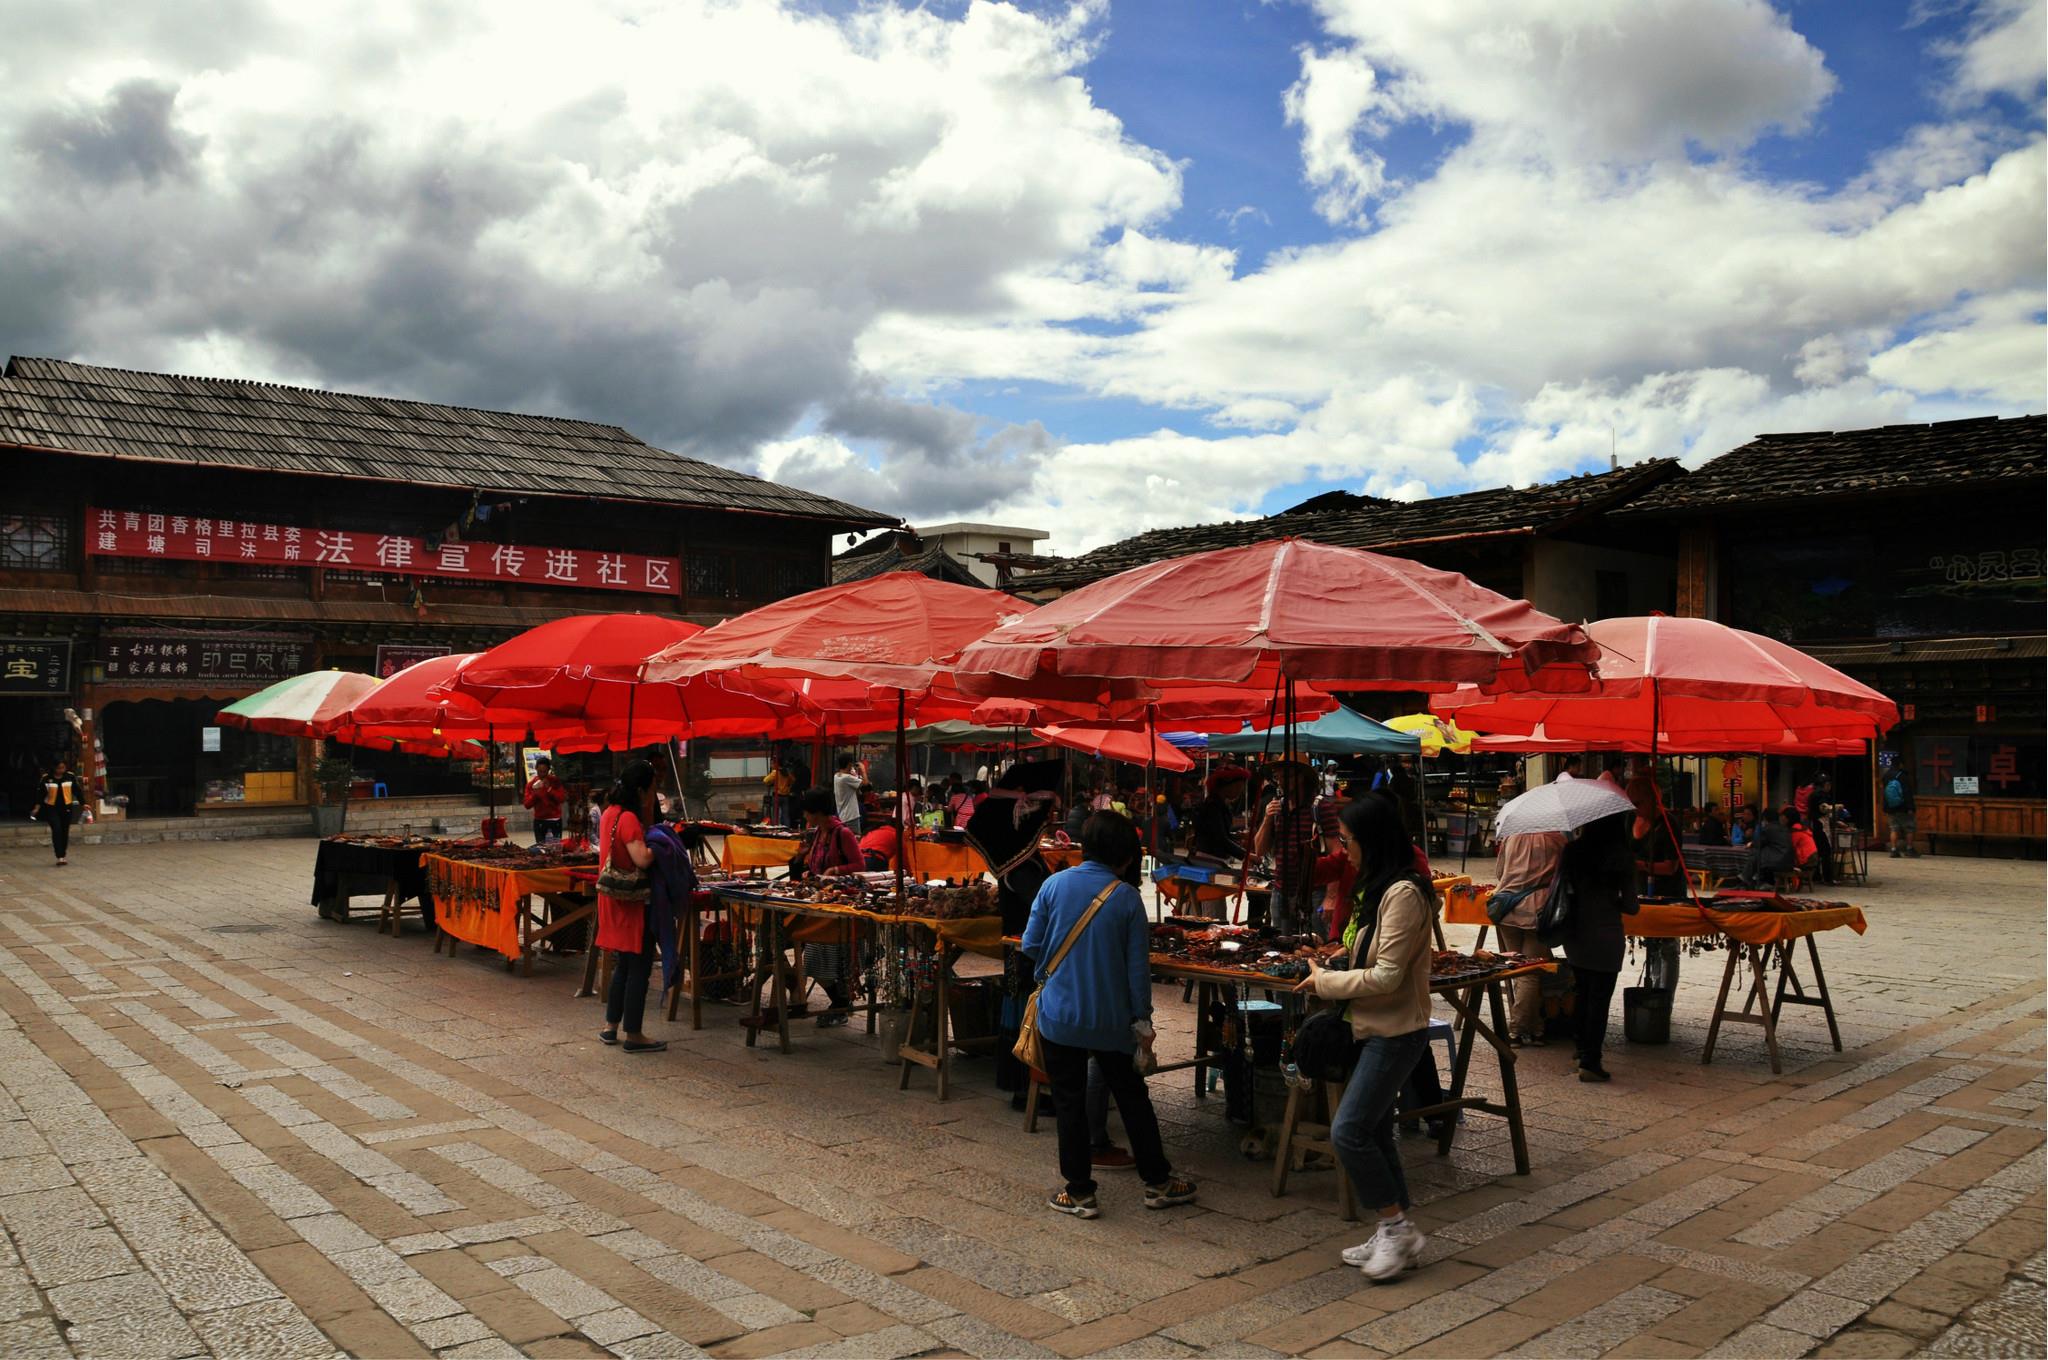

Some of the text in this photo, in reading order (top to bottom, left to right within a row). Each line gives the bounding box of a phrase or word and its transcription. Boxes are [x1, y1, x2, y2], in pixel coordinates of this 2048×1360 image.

[98, 510, 302, 543] 共青团香格里拉县委
[98, 531, 301, 561] 建塘司法所
[315, 530, 671, 589] 法律宣传进社区
[201, 651, 301, 672] 印巴风情
